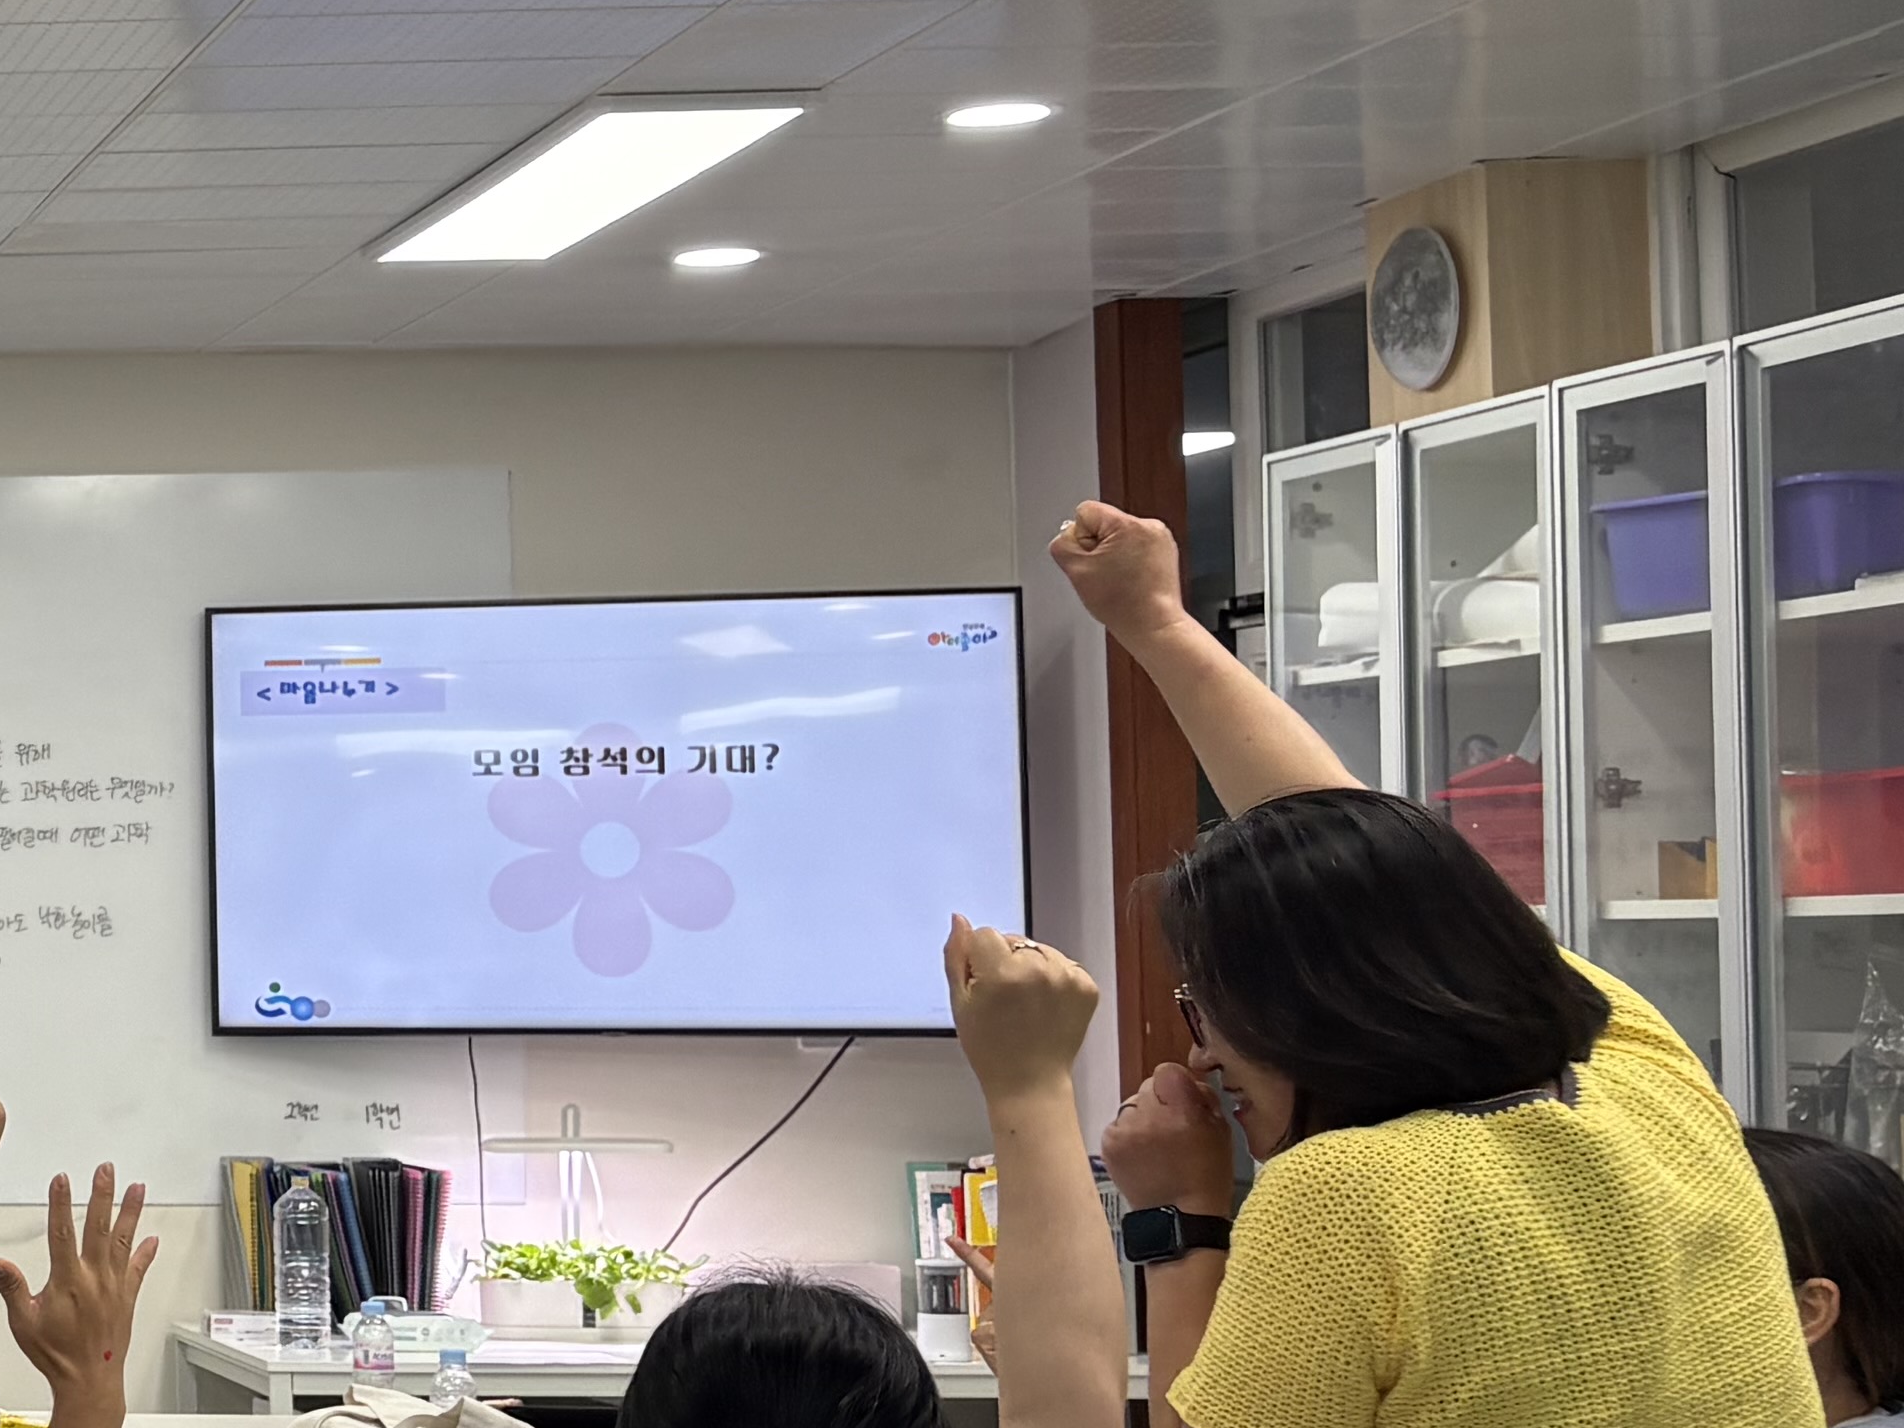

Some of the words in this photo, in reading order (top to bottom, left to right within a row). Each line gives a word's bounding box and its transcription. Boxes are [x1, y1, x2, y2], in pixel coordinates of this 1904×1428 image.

[14, 743, 52, 767] 위해
[472, 746, 541, 778] 모임
[559, 745, 667, 777] 참석의
[686, 741, 780, 776] 기대?
[110, 821, 153, 846] 과학
[365, 1101, 401, 1131] 1학년
